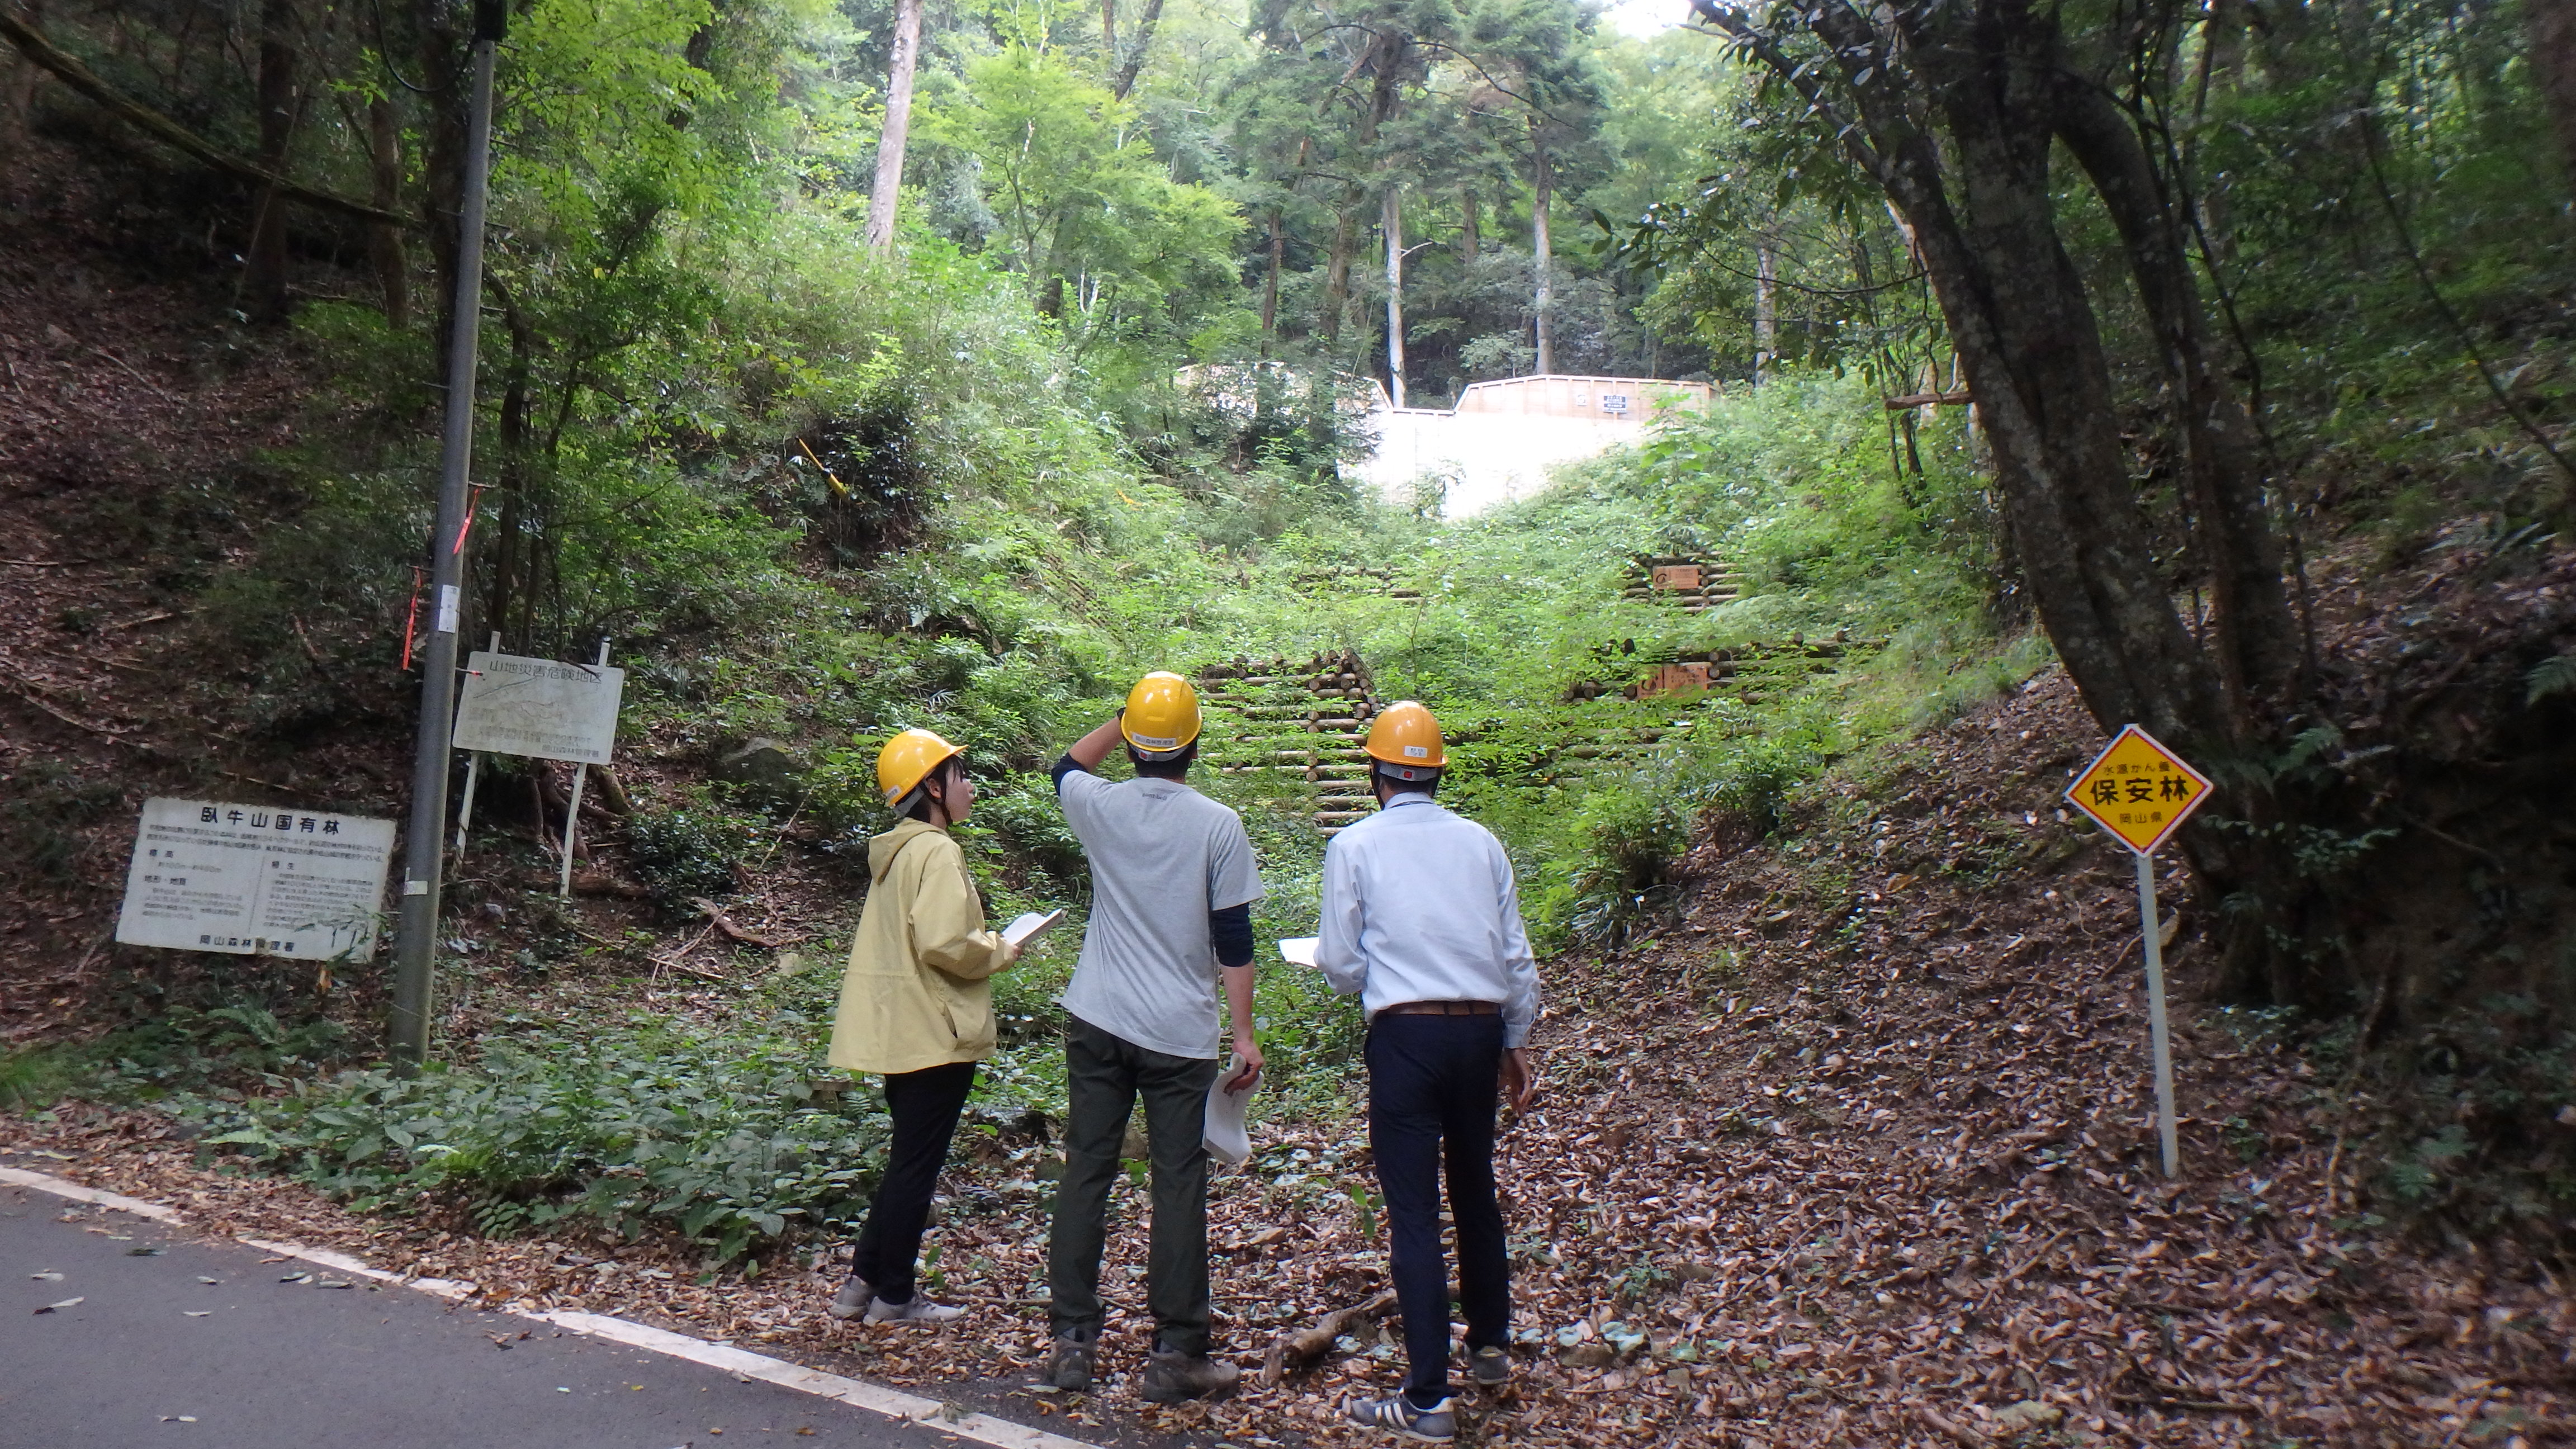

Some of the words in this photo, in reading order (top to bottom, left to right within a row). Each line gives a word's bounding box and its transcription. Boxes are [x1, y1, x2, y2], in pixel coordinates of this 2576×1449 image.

[489, 660, 603, 684] 山地災害危険地区
[2090, 775, 2189, 806] 保安林
[201, 807, 340, 835] 臥牛山国有林
[2120, 811, 2163, 824] 岡山県
